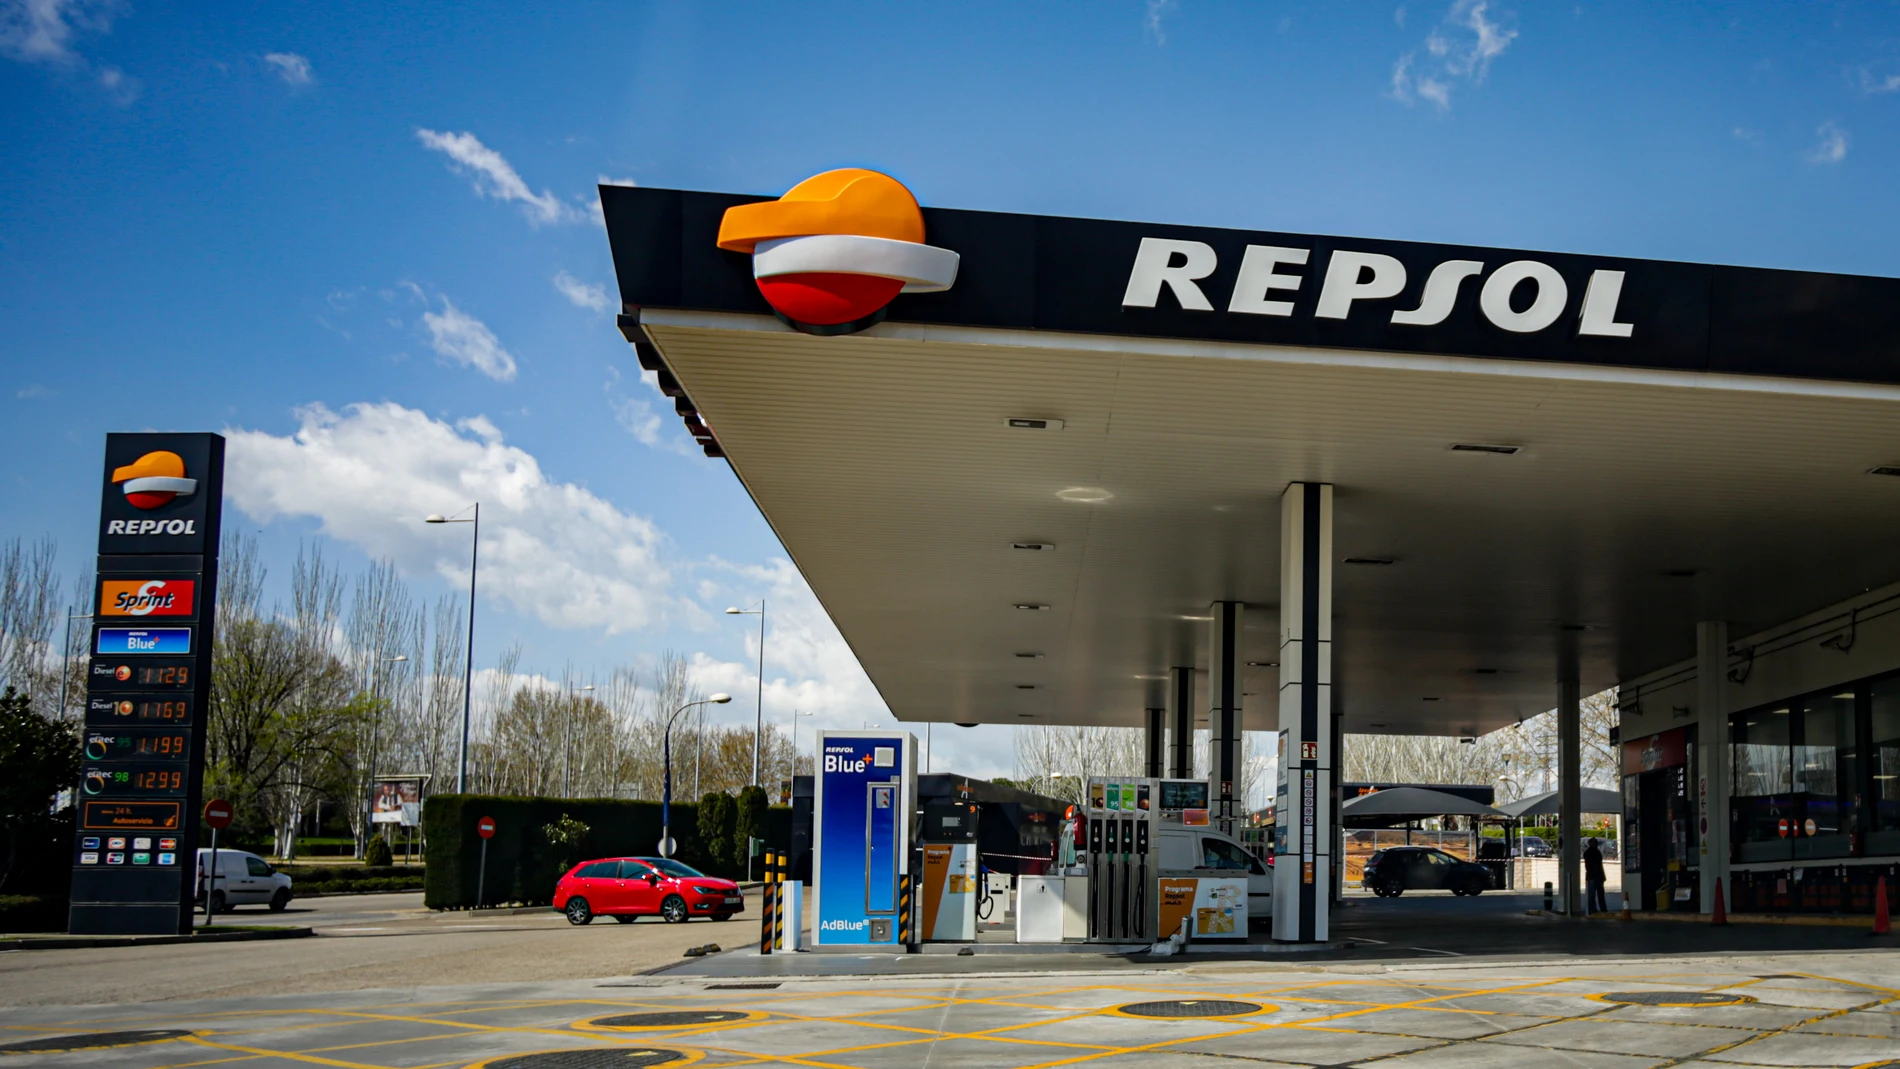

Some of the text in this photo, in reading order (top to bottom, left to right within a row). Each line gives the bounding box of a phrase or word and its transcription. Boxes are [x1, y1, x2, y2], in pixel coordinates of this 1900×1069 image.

[1122, 237, 1634, 338] REPSOL
[107, 519, 196, 535] REPSOL
[114, 591, 176, 612] Sprint
[94, 667, 115, 675] Diesel
[92, 702, 113, 710] Diesel
[117, 737, 132, 747] 95
[114, 772, 129, 782] 98
[115, 807, 123, 815] 24
[969, 805, 976, 813] 9
[112, 817, 154, 825] Autoservicio
[1164, 886, 1194, 894] Programa
[1164, 893, 1185, 901] Repsol
